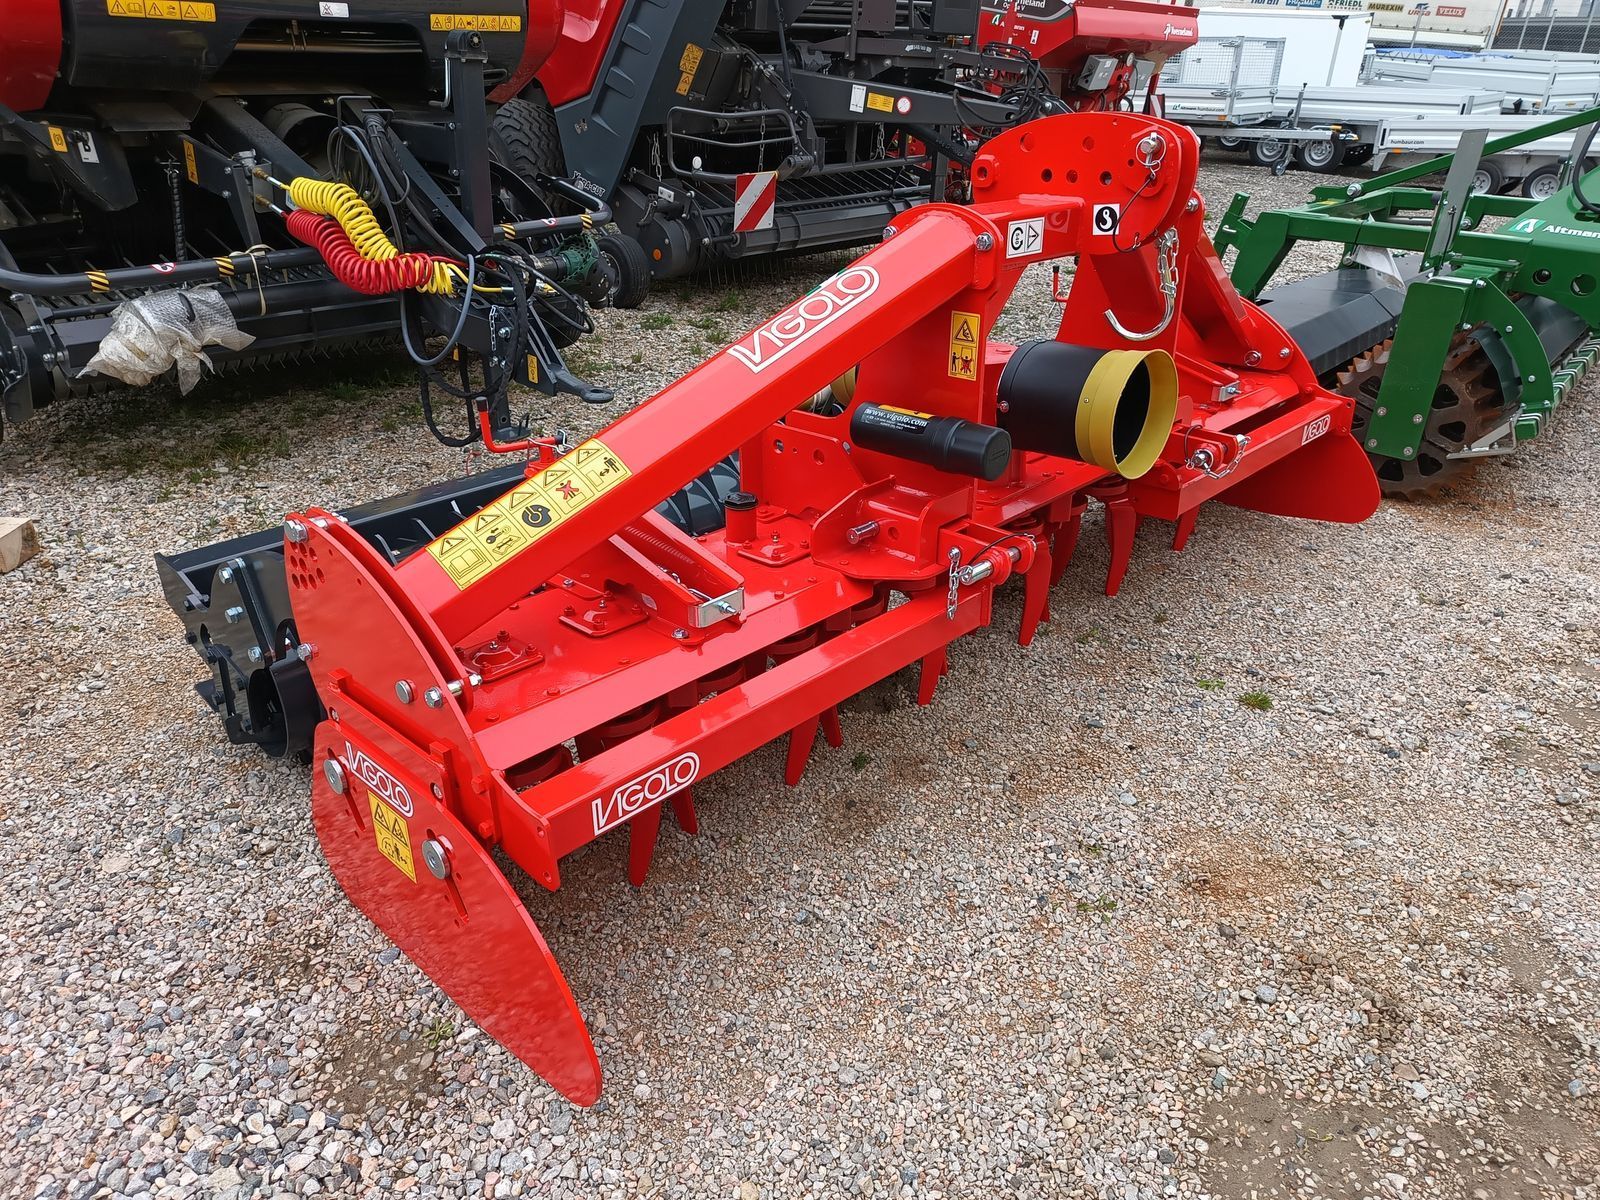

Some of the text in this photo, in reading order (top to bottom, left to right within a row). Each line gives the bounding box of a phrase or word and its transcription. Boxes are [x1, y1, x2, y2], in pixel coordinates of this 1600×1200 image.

[1368, 3, 1404, 12] MUREXIN
[1439, 7, 1464, 16] VELUX
[726, 265, 880, 374] VIGOLO
[863, 408, 929, 428] www.vigolo.com
[1301, 414, 1331, 446] VIGOLO
[345, 740, 414, 818] VIGOLO
[591, 751, 700, 837] VIGOLO
